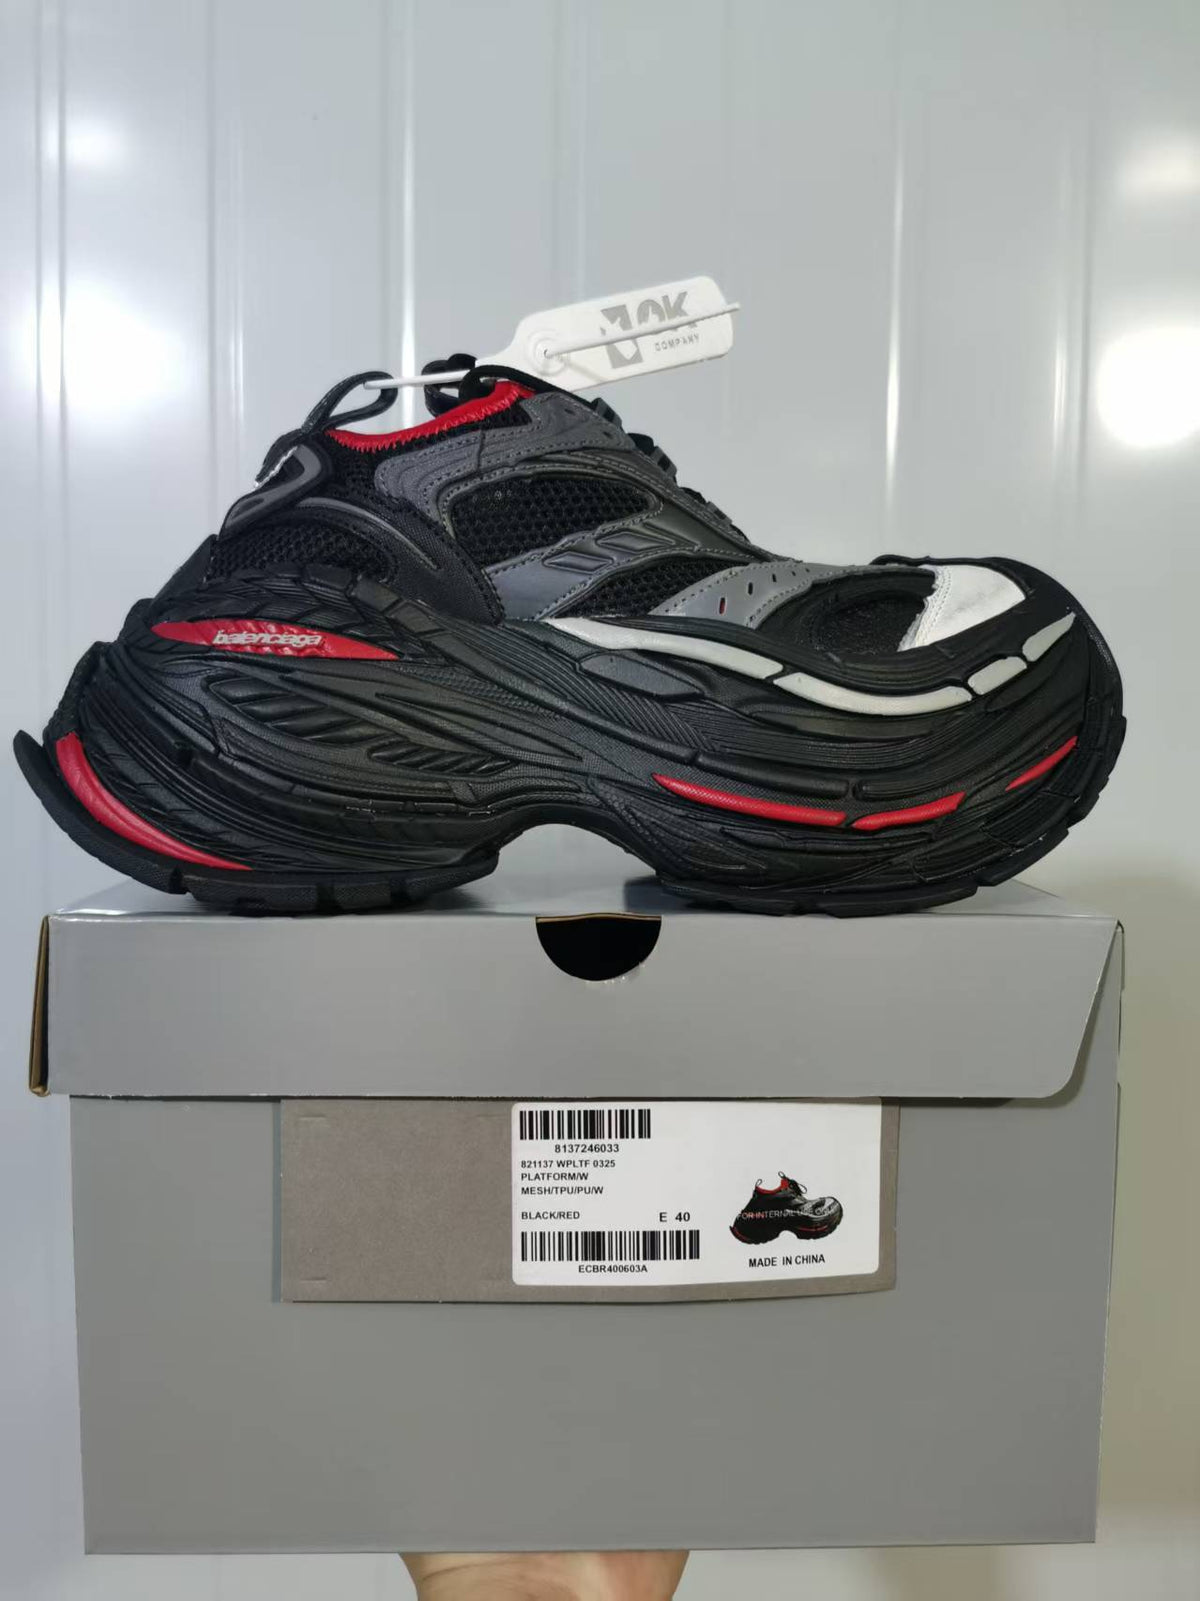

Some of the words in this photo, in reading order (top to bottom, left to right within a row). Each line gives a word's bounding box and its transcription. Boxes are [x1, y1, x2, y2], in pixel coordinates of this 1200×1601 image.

[655, 333, 700, 351] COMPANY
[554, 1143, 620, 1154] 8137246033
[521, 1159, 553, 1169] 821137
[556, 1159, 590, 1168] WPLTF
[593, 1159, 616, 1168] 0325
[521, 1172, 589, 1181] PLATFORM/W
[521, 1186, 604, 1195] MESH/TPU/PU/W
[521, 1211, 580, 1220] BLACK/RED
[659, 1211, 668, 1223] E
[675, 1211, 691, 1223] 40
[749, 1256, 778, 1268] MADE
[782, 1255, 793, 1266] IN
[795, 1253, 826, 1265] CHINA
[578, 1264, 648, 1273] ECBR400603A
